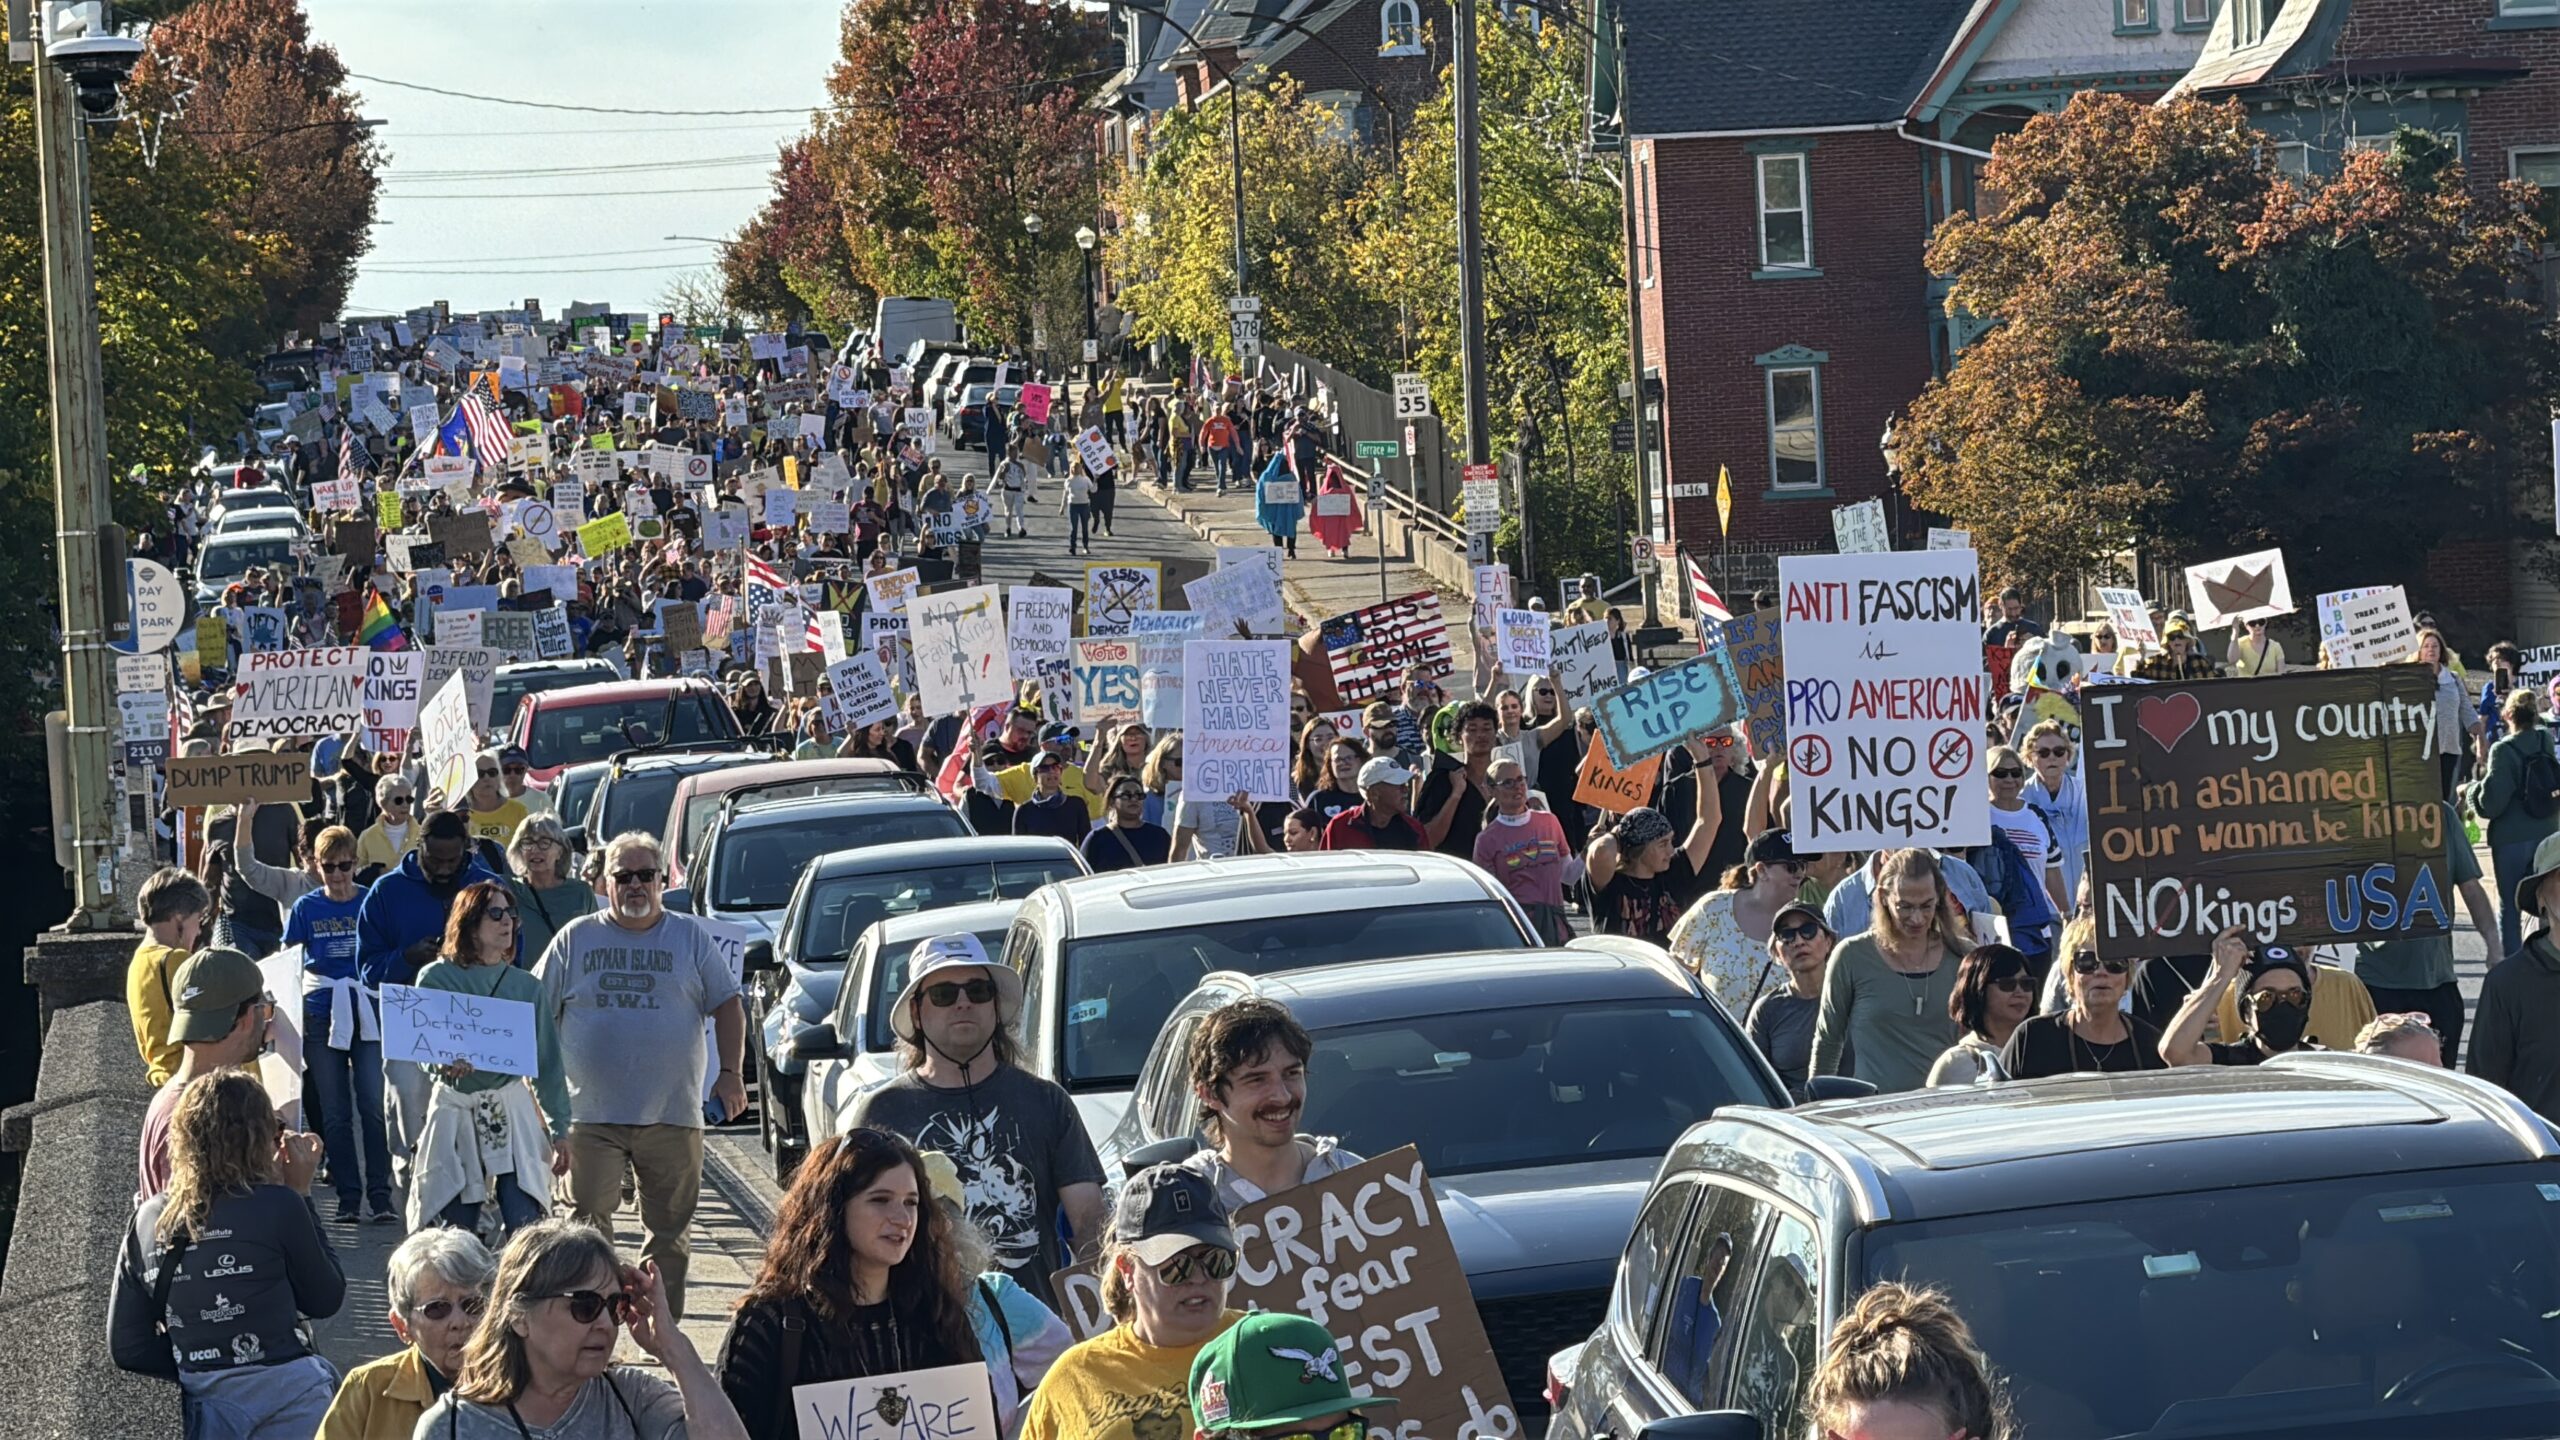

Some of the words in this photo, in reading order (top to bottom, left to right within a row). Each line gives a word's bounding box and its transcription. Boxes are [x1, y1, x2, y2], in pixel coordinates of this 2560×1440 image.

[1238, 300, 1252, 309] TO
[1233, 320, 1258, 337] 378
[841, 396, 854, 404] ICE
[1399, 387, 1423, 395] LIMIT
[1399, 396, 1426, 413] 35
[1080, 439, 1104, 472] LOSER
[1359, 443, 1385, 456] Terrace
[314, 482, 338, 495] WAKE
[341, 481, 353, 491] UP
[1679, 485, 1703, 496] 146
[933, 514, 951, 528] NO
[1850, 507, 1865, 525] THE
[1838, 533, 1849, 550] BY
[1852, 527, 1867, 542] THE
[1099, 568, 1150, 588] RESIST
[1480, 571, 1508, 593] EAT
[139, 586, 163, 596] PAY
[1786, 581, 1848, 624] ANTI
[1858, 573, 1978, 625] FASCISM
[140, 602, 156, 612] TO
[1015, 602, 1070, 624] FREEDOM
[1502, 611, 1533, 625] LOUD
[2354, 607, 2379, 619] TREAT
[2385, 602, 2396, 611] US
[141, 617, 174, 628] PARK
[483, 617, 529, 640] FREE
[870, 618, 908, 629] PROT
[1032, 623, 1053, 635] AND
[1088, 625, 1129, 636] DEMOG
[1132, 615, 1200, 631] DEMOCRACY
[1509, 626, 1544, 639] ANGRY
[1724, 614, 1758, 645] If
[2350, 626, 2367, 636] LIKE
[2371, 617, 2400, 630] RUSSIA
[1011, 637, 1067, 654] DEMOCRACY
[1371, 623, 1405, 647] DO
[1512, 638, 1546, 654] GIRLS
[1576, 629, 1609, 654] NEED
[1858, 631, 1898, 660] is
[2353, 641, 2365, 650] WE
[2394, 628, 2410, 639] LIKE
[251, 648, 359, 671] PROTECT
[431, 650, 489, 666] DEFEND
[1207, 650, 1278, 677] HATE
[1370, 636, 1441, 669] SOME
[1737, 642, 1778, 667] are
[856, 670, 873, 681] THE
[1073, 664, 1140, 709] YES
[1338, 657, 1450, 701] THIG
[1583, 664, 1618, 697] THANG
[241, 675, 351, 712] AMERICAN
[364, 680, 416, 701] KINGS
[839, 679, 885, 700] BASTARDS
[849, 692, 878, 708] GRIND
[1198, 676, 1284, 704] NEVER
[1620, 661, 1708, 718] RISE
[1786, 678, 1841, 726] PRO
[1848, 674, 1981, 721] AMERICAN
[363, 709, 382, 726] NO
[847, 708, 867, 720] YOU
[868, 697, 892, 713] DOWN
[1202, 704, 1270, 730] MADE
[1641, 701, 1691, 739] UP
[230, 713, 361, 739] DEMOCRACY
[427, 692, 465, 755] LOVE
[2090, 695, 2128, 749] I
[2207, 708, 2279, 762] my
[2295, 696, 2437, 760] country
[130, 746, 163, 757] 2110
[369, 728, 410, 752] TRUM
[428, 719, 468, 776] AMERICA
[1187, 732, 1285, 756] America
[1848, 736, 1916, 780] NO
[172, 765, 231, 788] DUMP
[234, 762, 306, 787] TRUMP
[1197, 759, 1285, 796] GREAT
[1588, 766, 1643, 801] KINGS
[2098, 759, 2179, 815] I'm
[2196, 756, 2377, 809] ashamed
[1810, 785, 1958, 838] KINGS!
[2101, 824, 2181, 862] our
[2198, 819, 2306, 852] wanna
[2313, 808, 2350, 842] be
[2362, 802, 2443, 849] king
[2105, 877, 2190, 939] NO
[2195, 883, 2298, 944] kings
[2325, 862, 2450, 934] USA
[583, 947, 627, 974] CAYMAN
[631, 947, 673, 972] ISLANDS
[450, 994, 483, 1017] No
[412, 1008, 514, 1038] Dictators
[411, 1033, 518, 1067] America
[204, 1265, 253, 1278] LEXUS
[1297, 1246, 1418, 1326] fear
[200, 1304, 246, 1320] Aardvark
[189, 1348, 221, 1361] ucan
[812, 1386, 877, 1440] WE
[901, 1394, 976, 1440] ARE
